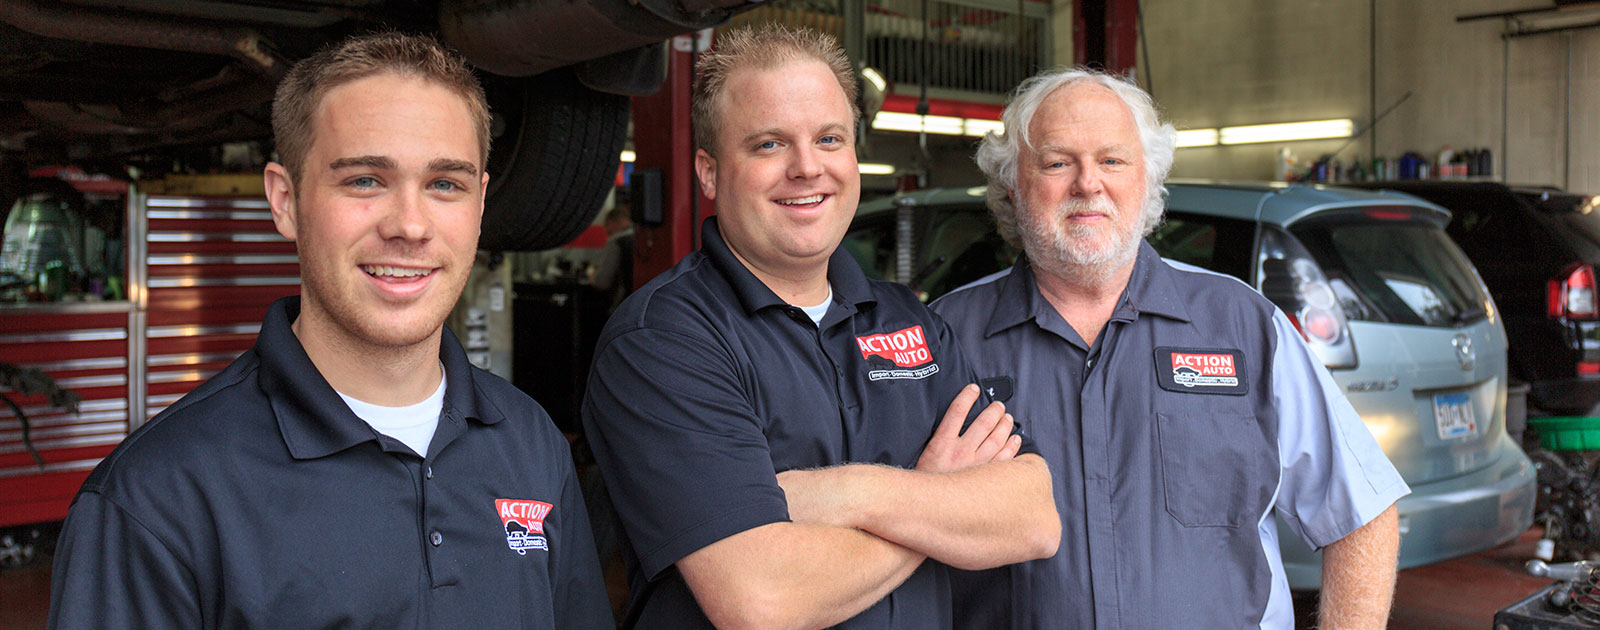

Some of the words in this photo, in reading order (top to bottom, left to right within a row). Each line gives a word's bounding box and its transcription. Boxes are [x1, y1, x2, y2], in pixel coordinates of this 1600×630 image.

[857, 329, 923, 352] ACTION
[895, 348, 928, 364] AUTO
[1175, 355, 1231, 366] ACTION
[501, 502, 549, 520] ACTION
